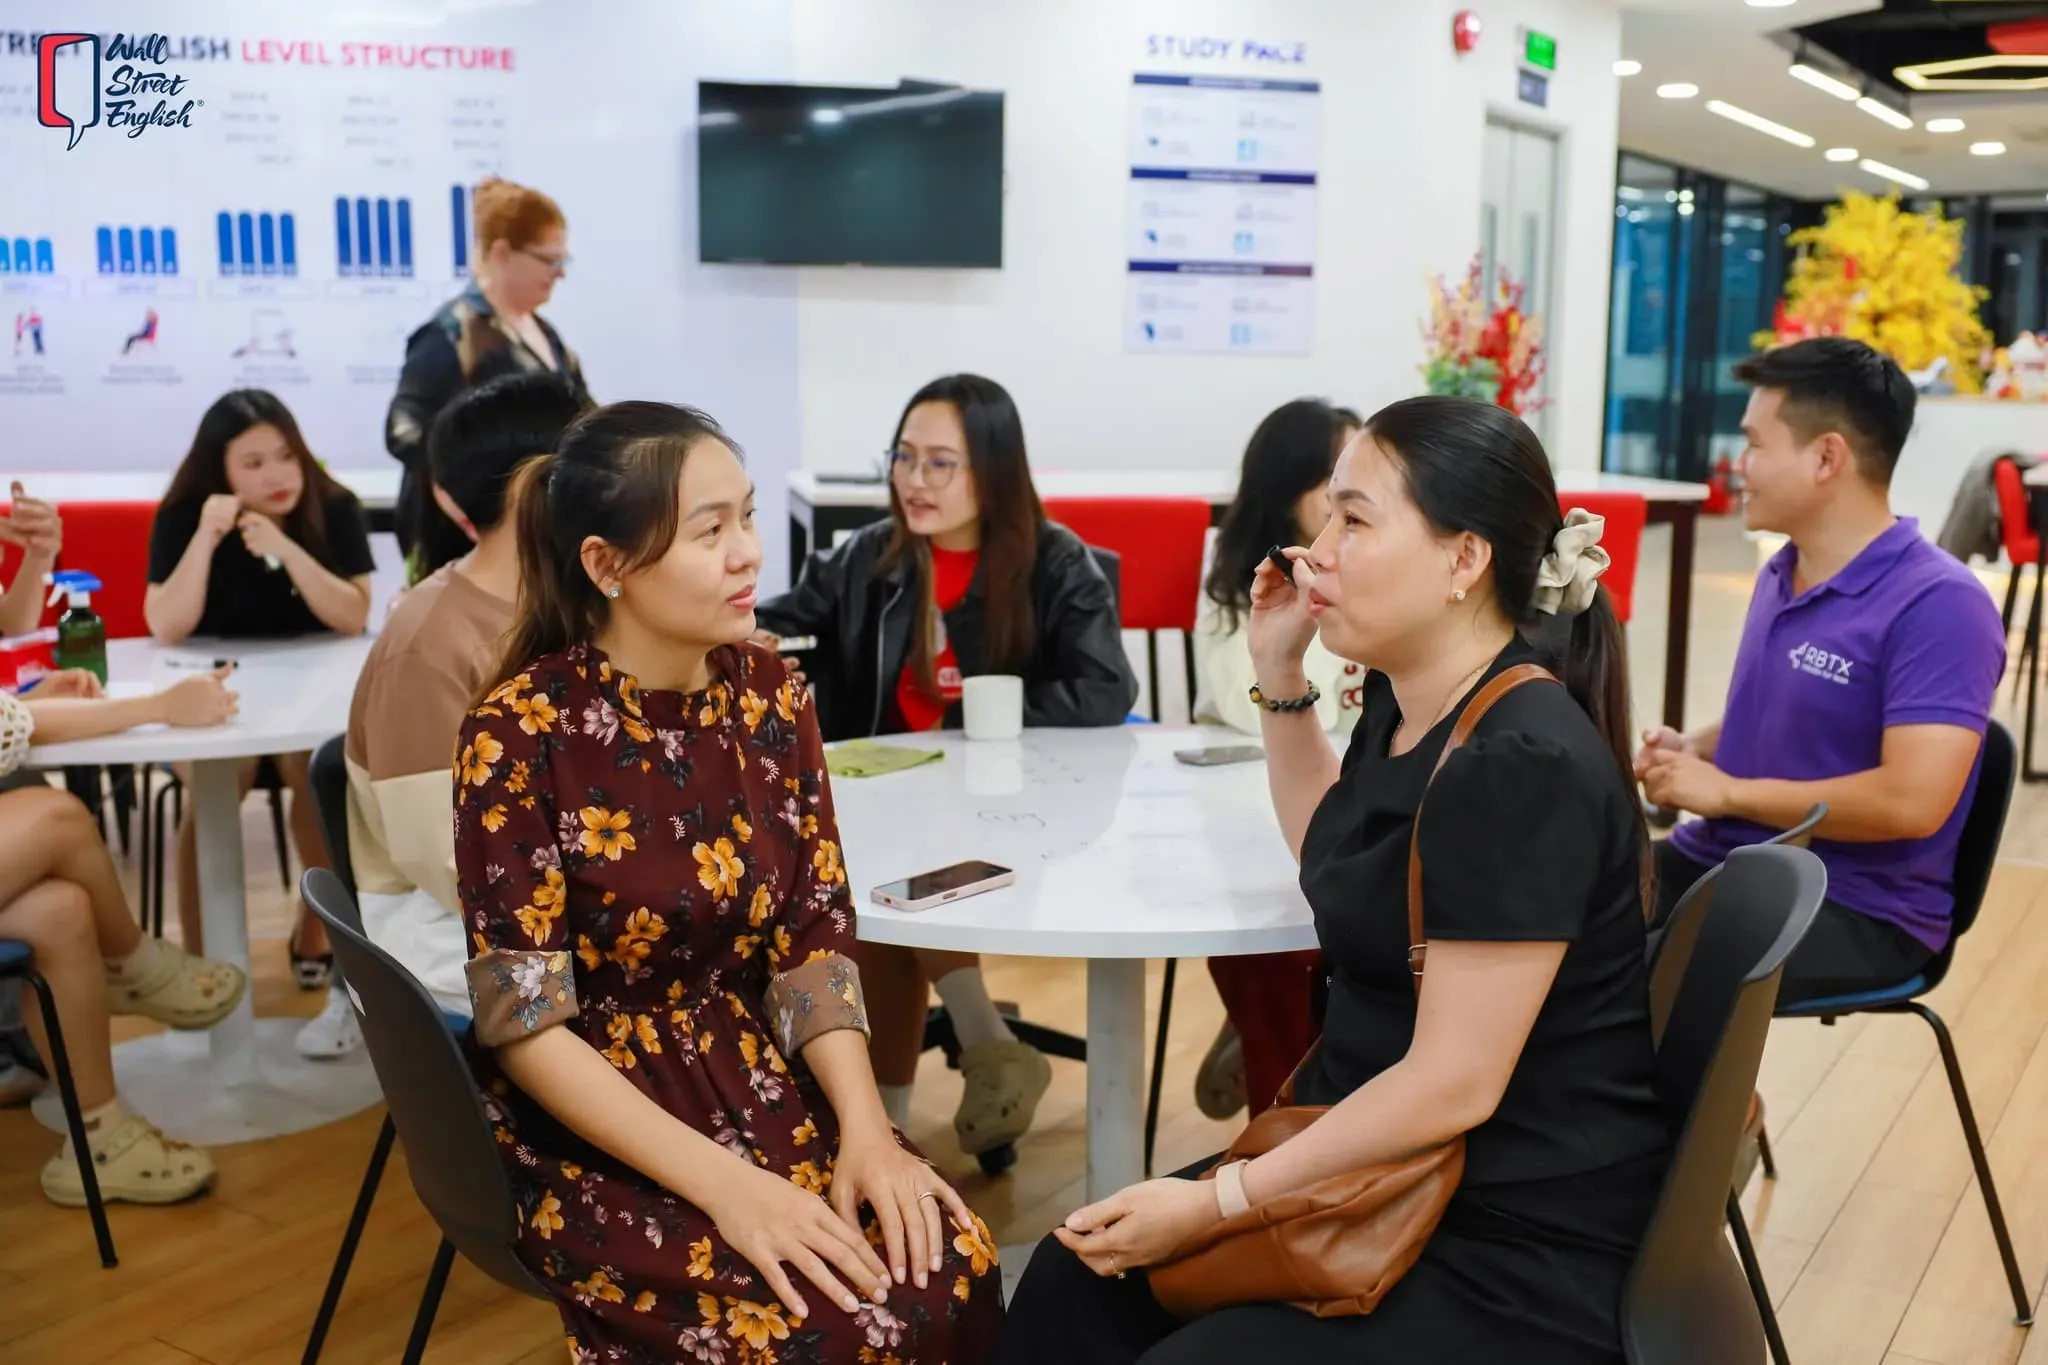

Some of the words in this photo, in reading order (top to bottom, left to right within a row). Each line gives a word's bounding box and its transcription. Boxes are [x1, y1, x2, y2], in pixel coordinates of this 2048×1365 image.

[241, 40, 330, 65] LEVEL
[341, 44, 515, 70] STRUCTURE
[1148, 35, 1231, 57] STUDY
